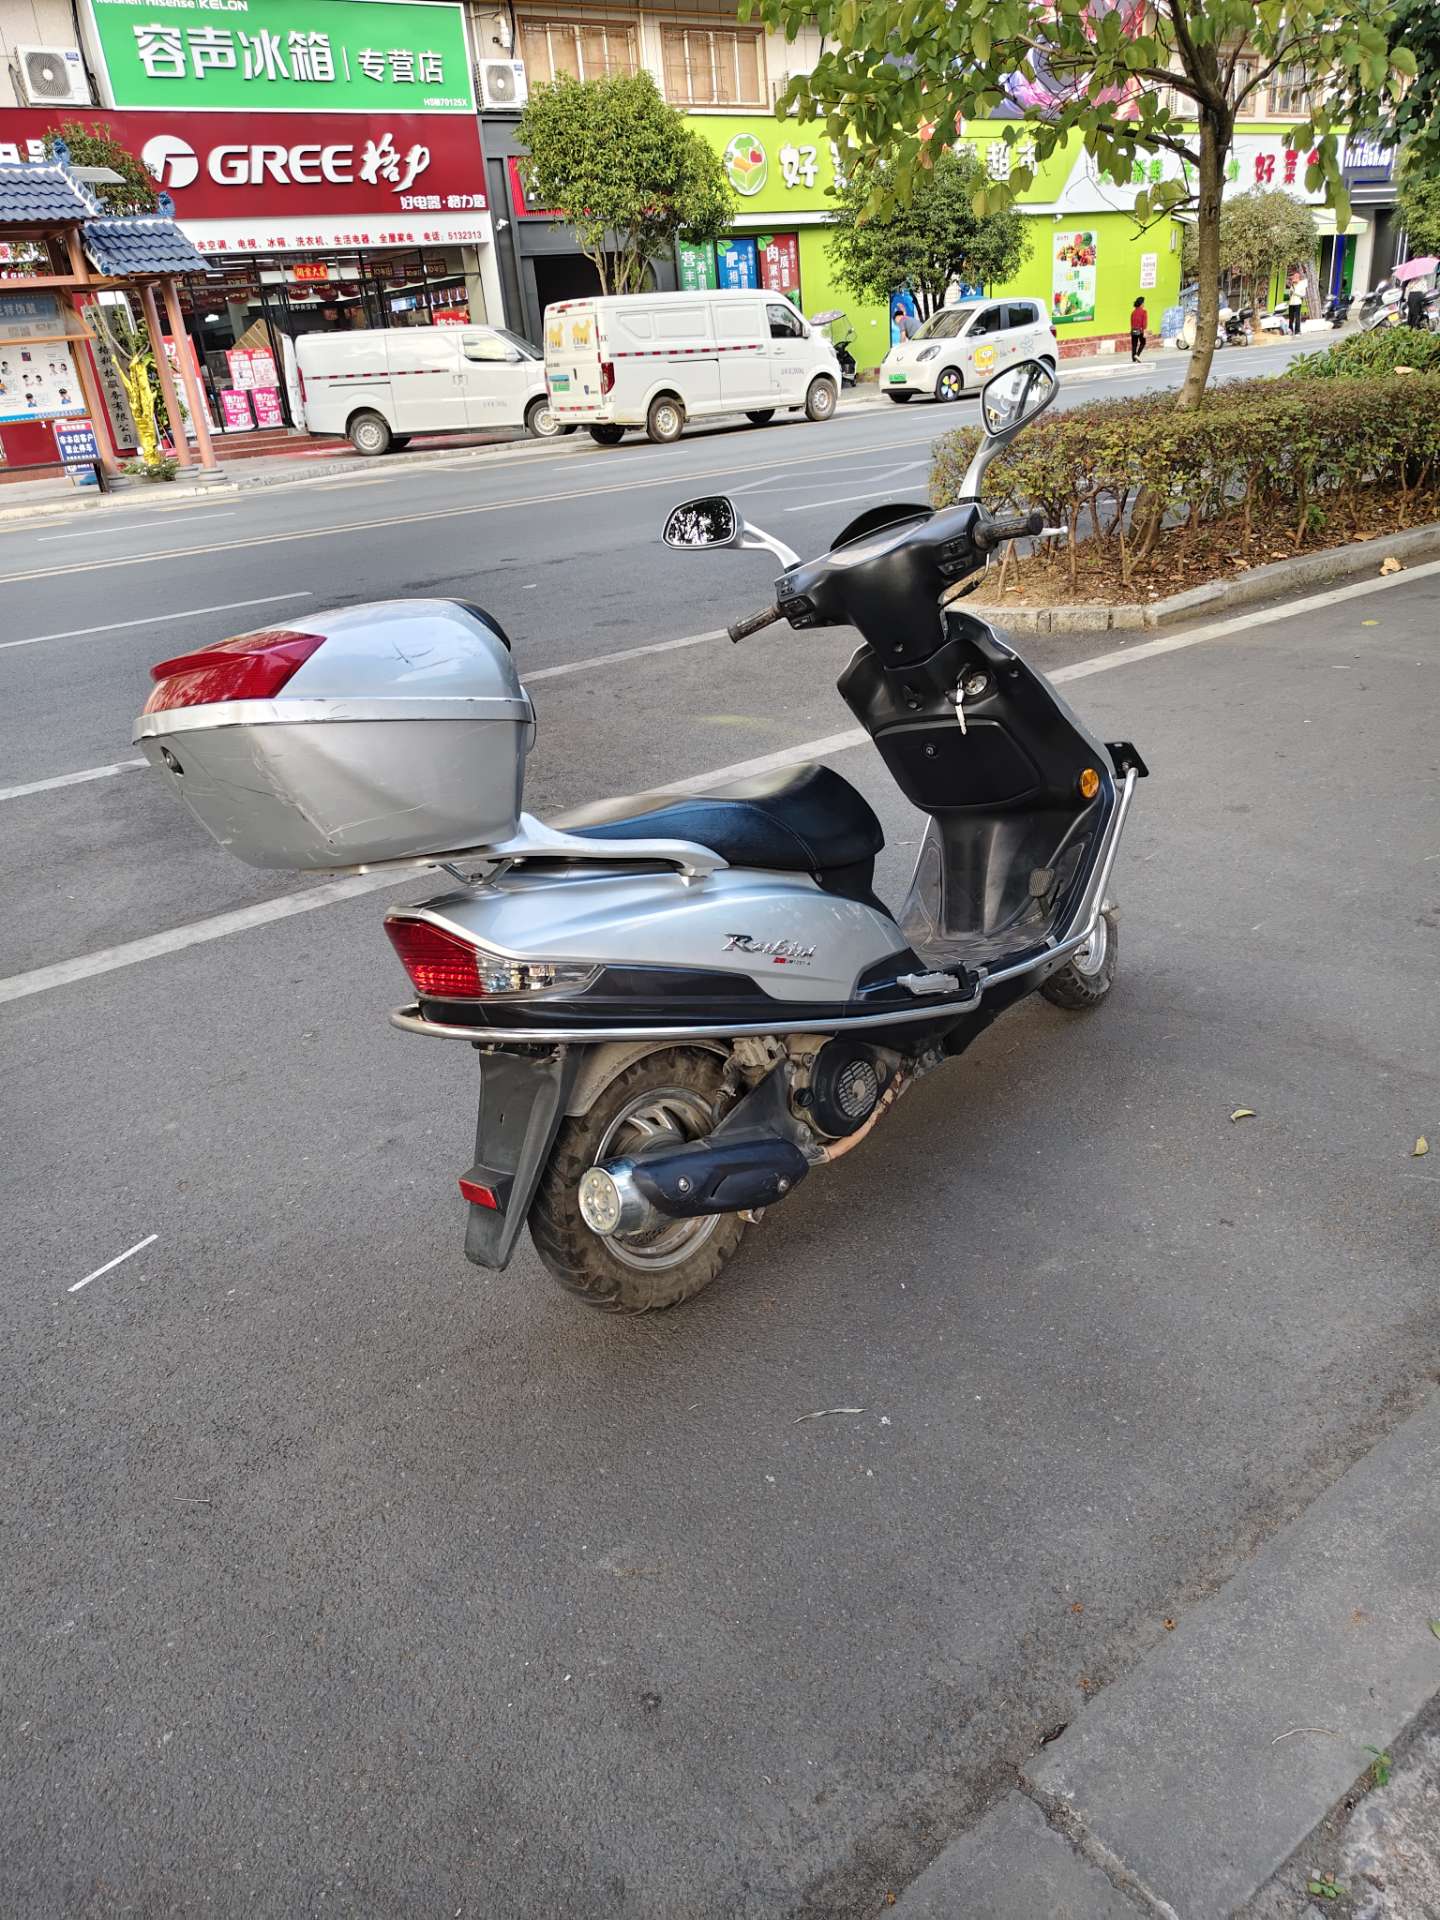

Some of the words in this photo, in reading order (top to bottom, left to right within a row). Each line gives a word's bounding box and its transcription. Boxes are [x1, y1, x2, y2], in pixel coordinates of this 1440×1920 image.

[199, 0, 249, 11] KELON
[133, 23, 336, 82] 容声冰箱
[358, 48, 445, 84] 专营店
[207, 145, 354, 185] GREE
[448, 231, 482, 240] 5132313
